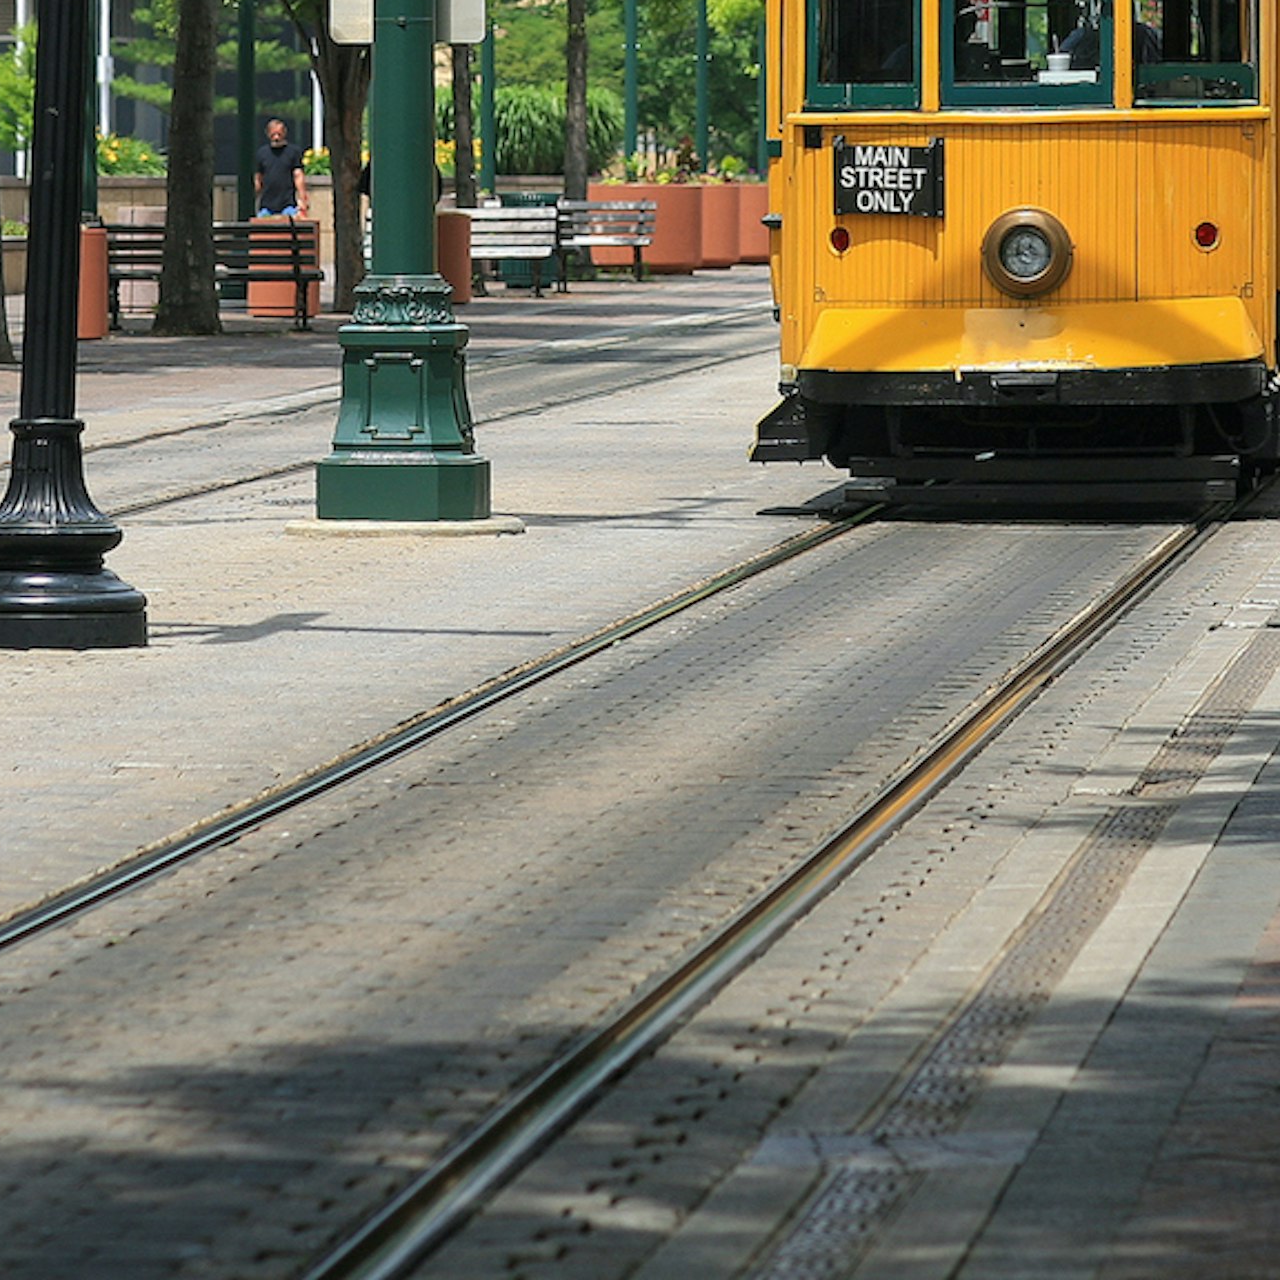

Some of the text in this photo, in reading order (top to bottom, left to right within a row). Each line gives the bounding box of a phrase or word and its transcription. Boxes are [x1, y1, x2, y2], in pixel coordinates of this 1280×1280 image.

[855, 146, 909, 167] MAIN
[840, 166, 927, 189] STREET
[856, 190, 914, 212] ONLY
